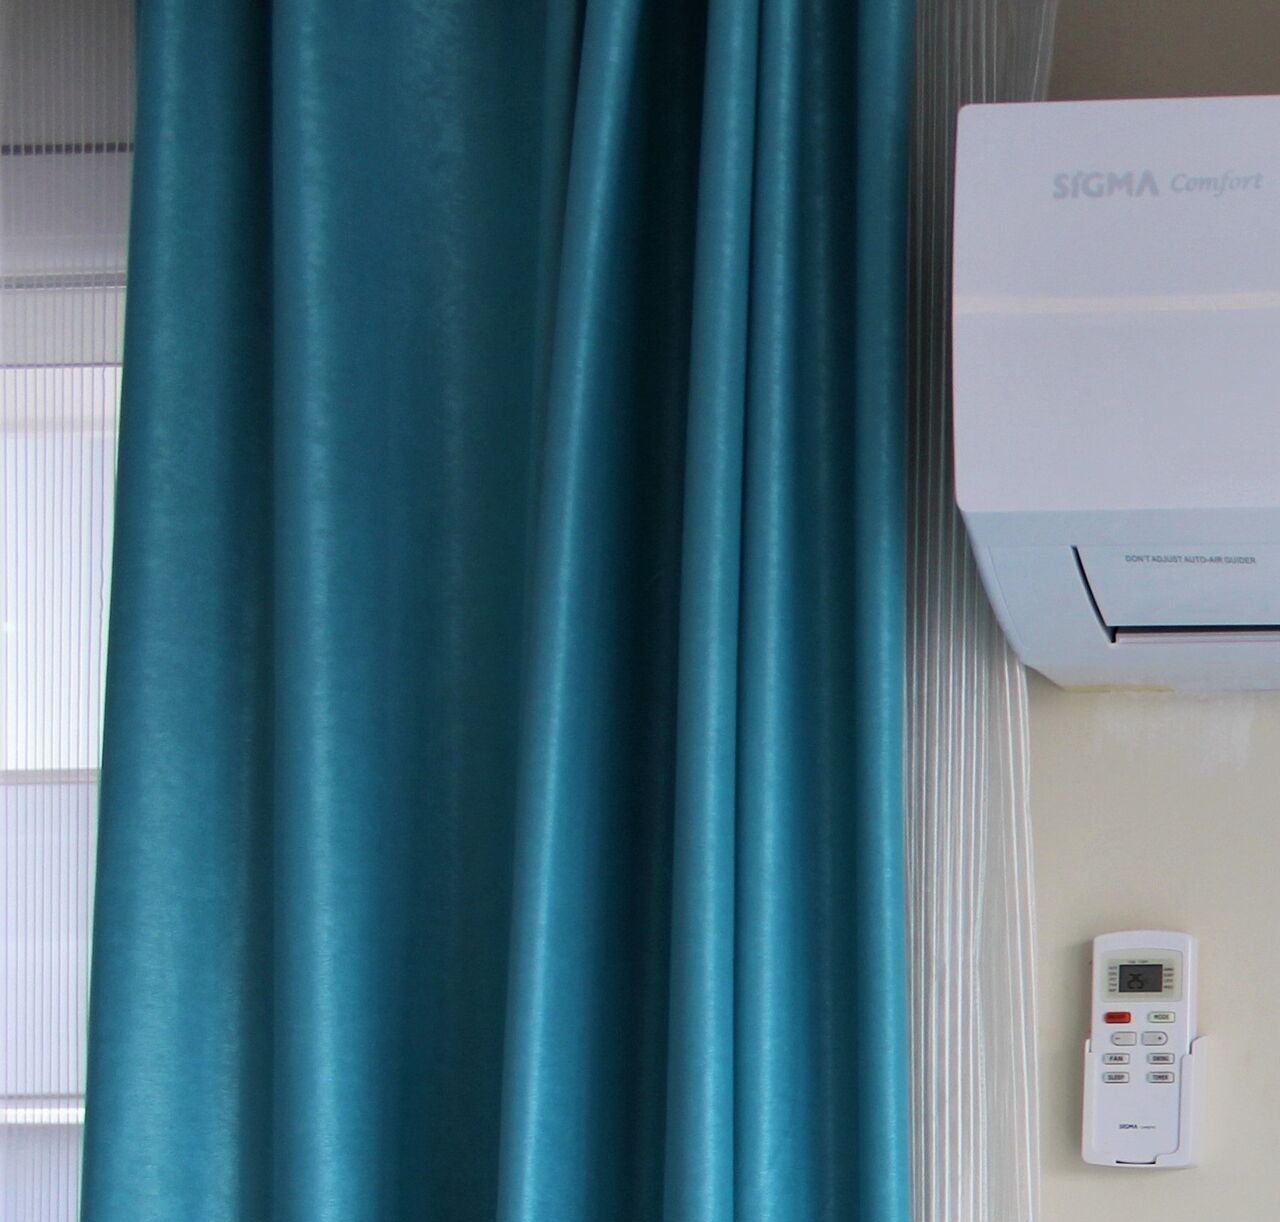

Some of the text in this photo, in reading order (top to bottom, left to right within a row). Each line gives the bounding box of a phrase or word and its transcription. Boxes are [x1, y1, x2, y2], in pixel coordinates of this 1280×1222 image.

[1169, 170, 1265, 198] Comfort
[1125, 555, 1150, 563] DON'T
[1152, 555, 1183, 564] ADJUST
[1225, 556, 1256, 565] GUIDER
